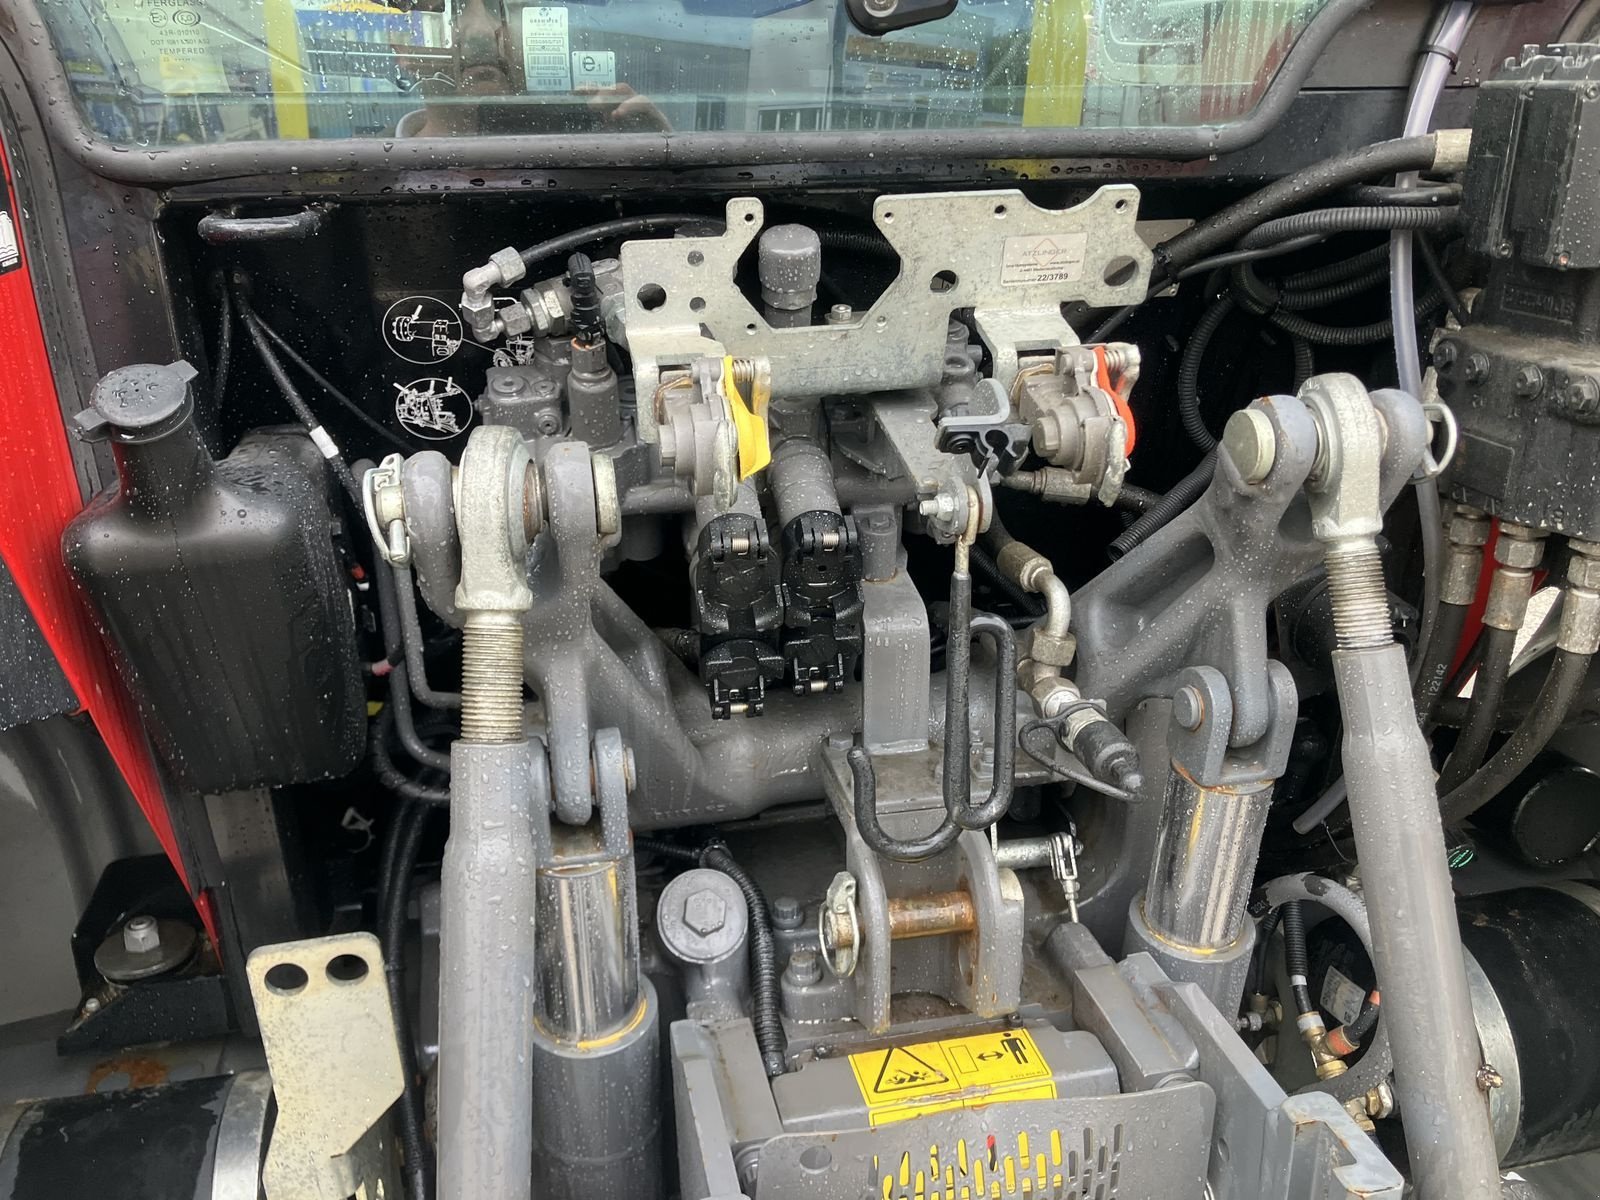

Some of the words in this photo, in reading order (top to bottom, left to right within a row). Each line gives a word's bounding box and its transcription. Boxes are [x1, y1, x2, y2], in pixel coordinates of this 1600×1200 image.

[159, 47, 205, 55] TEMPERED
[1037, 273, 1069, 282] 22/3789
[1428, 664, 1448, 696] 122142
